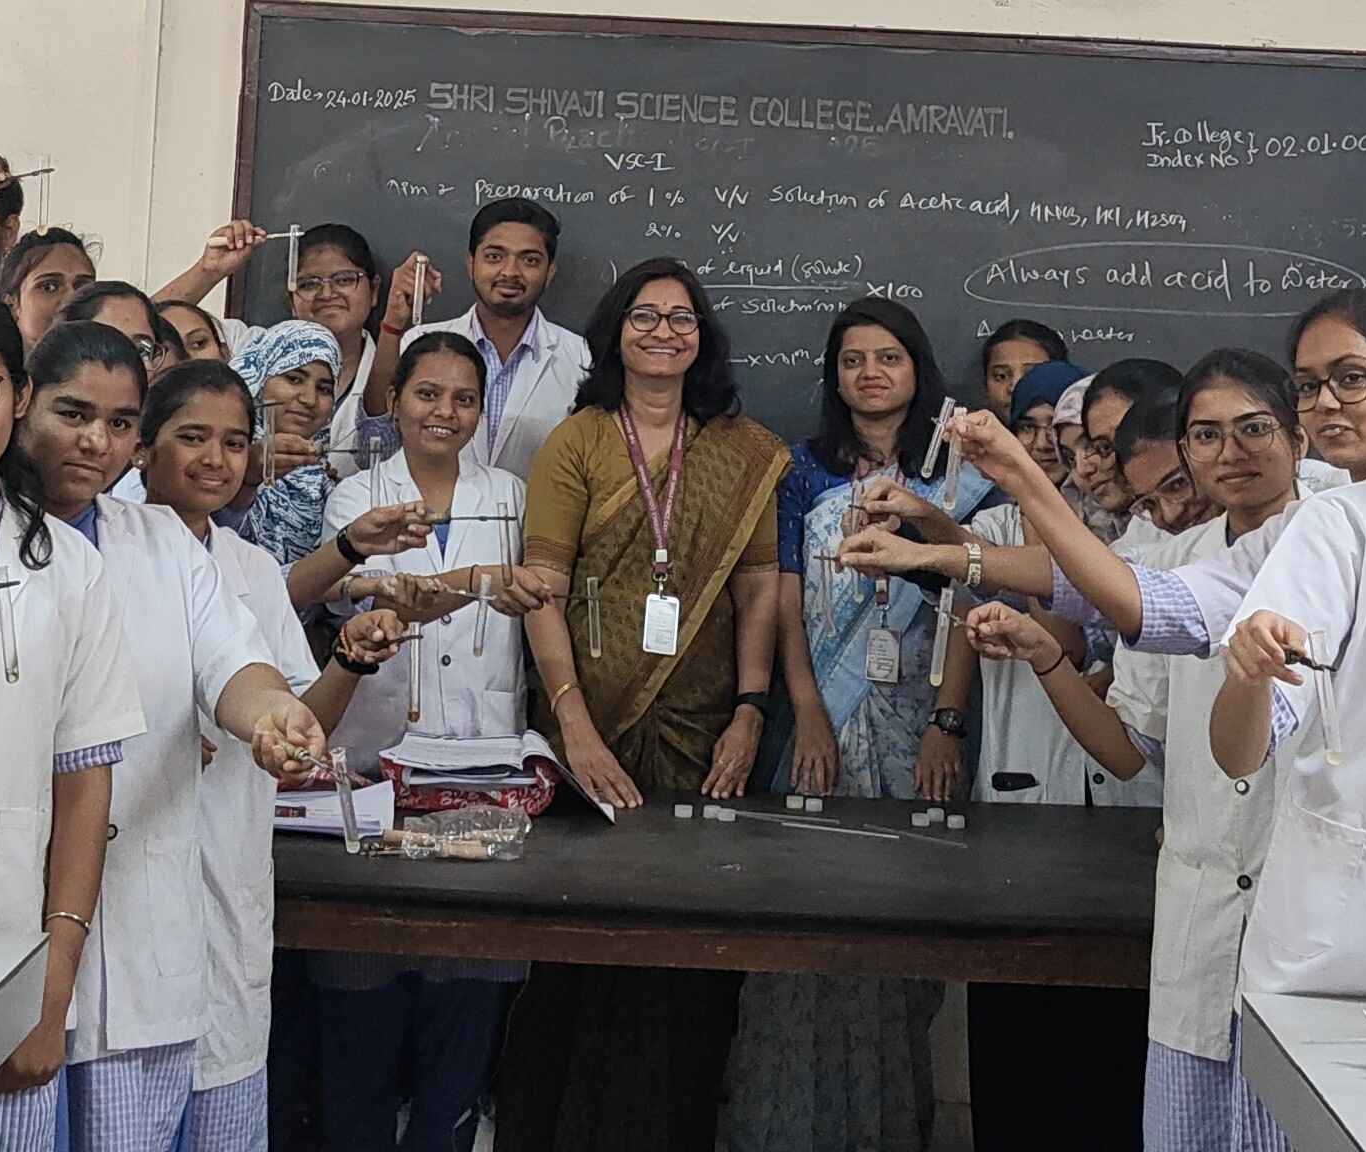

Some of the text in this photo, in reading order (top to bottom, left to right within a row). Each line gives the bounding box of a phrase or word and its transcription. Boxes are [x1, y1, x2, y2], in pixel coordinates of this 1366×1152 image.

[426, 82, 495, 114] SHRI
[503, 87, 605, 119] SHIVAJI
[614, 91, 740, 127] SCIENCE
[1105, 260, 1154, 288] add
[1163, 257, 1233, 301] acid
[1243, 260, 1272, 297] to
